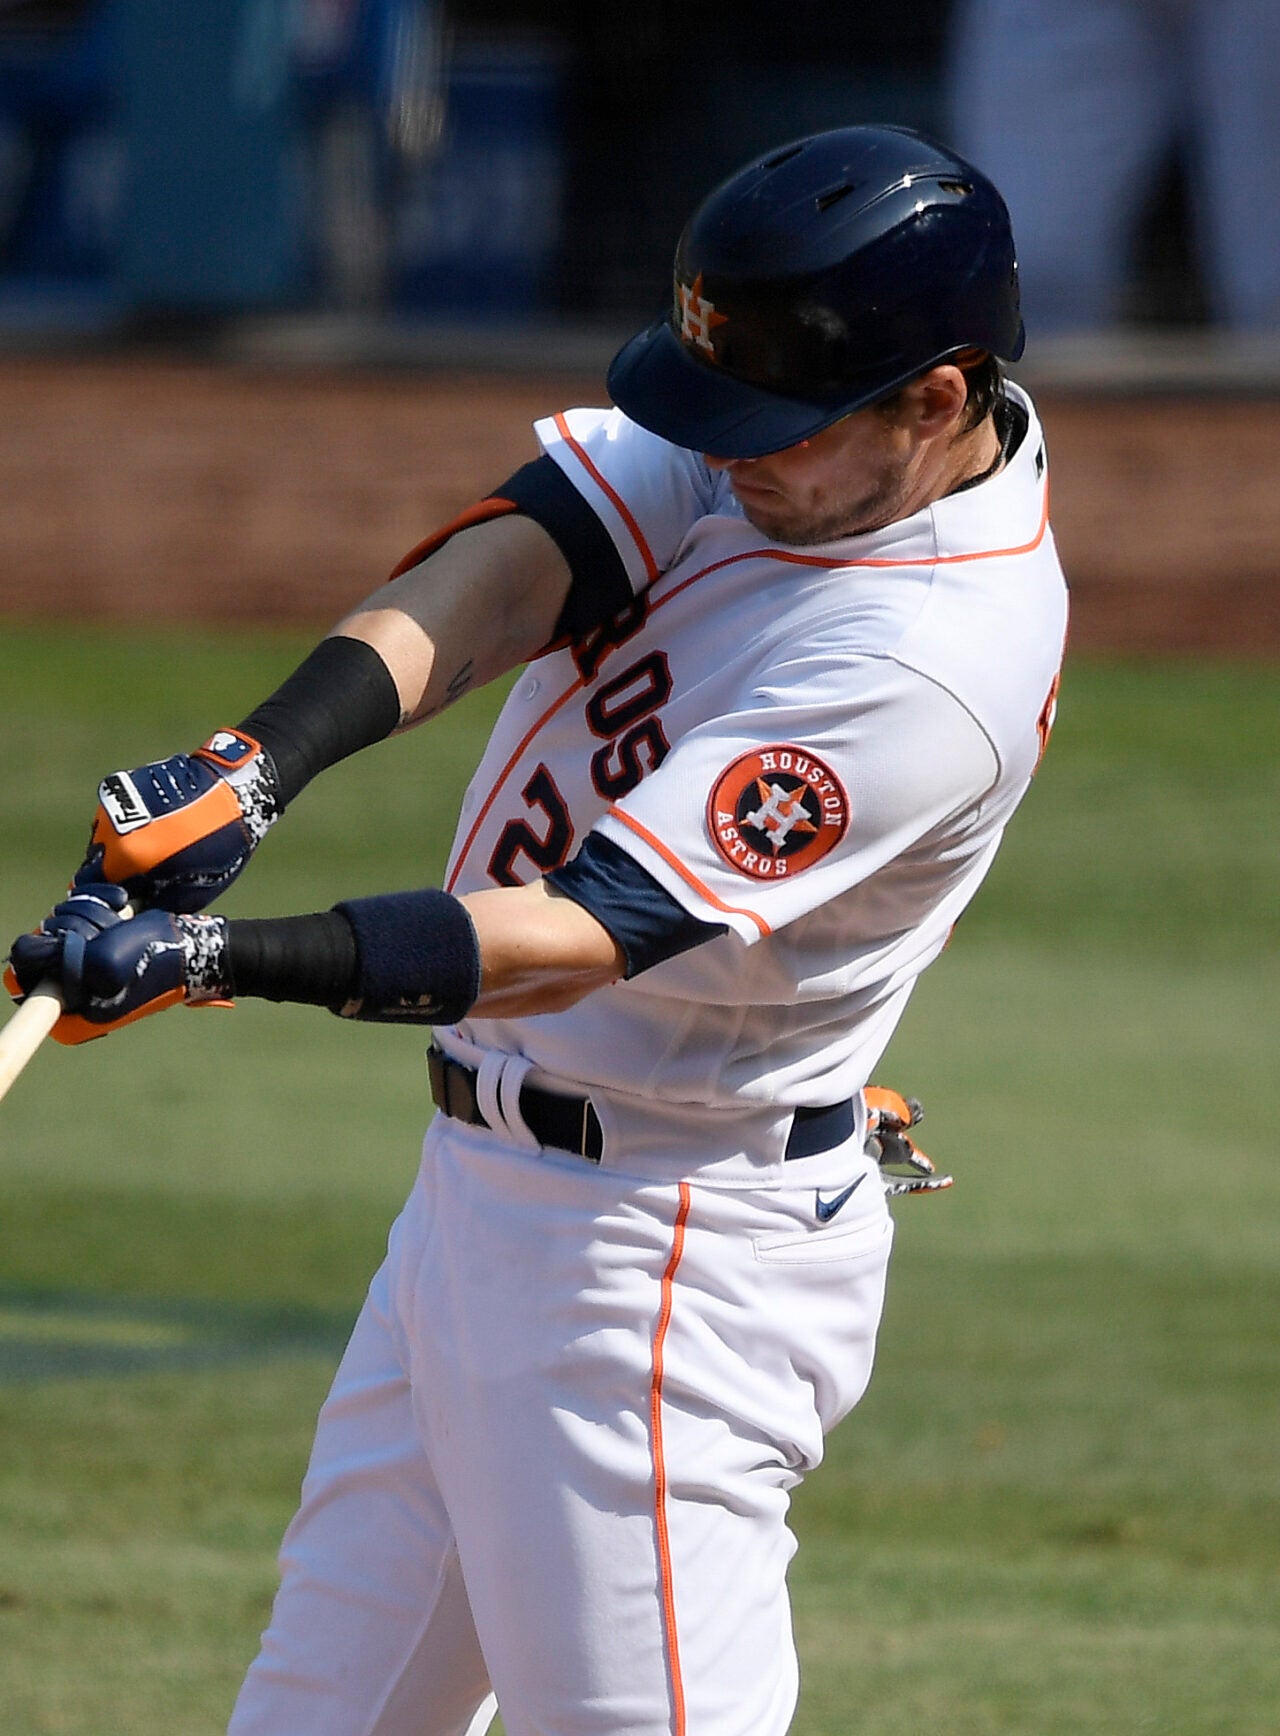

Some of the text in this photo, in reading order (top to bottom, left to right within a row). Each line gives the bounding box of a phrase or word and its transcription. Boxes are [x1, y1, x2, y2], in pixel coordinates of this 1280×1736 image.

[486, 761, 575, 888] 2
[759, 752, 843, 827] HOUSTON
[716, 810, 788, 876] ASTROS
